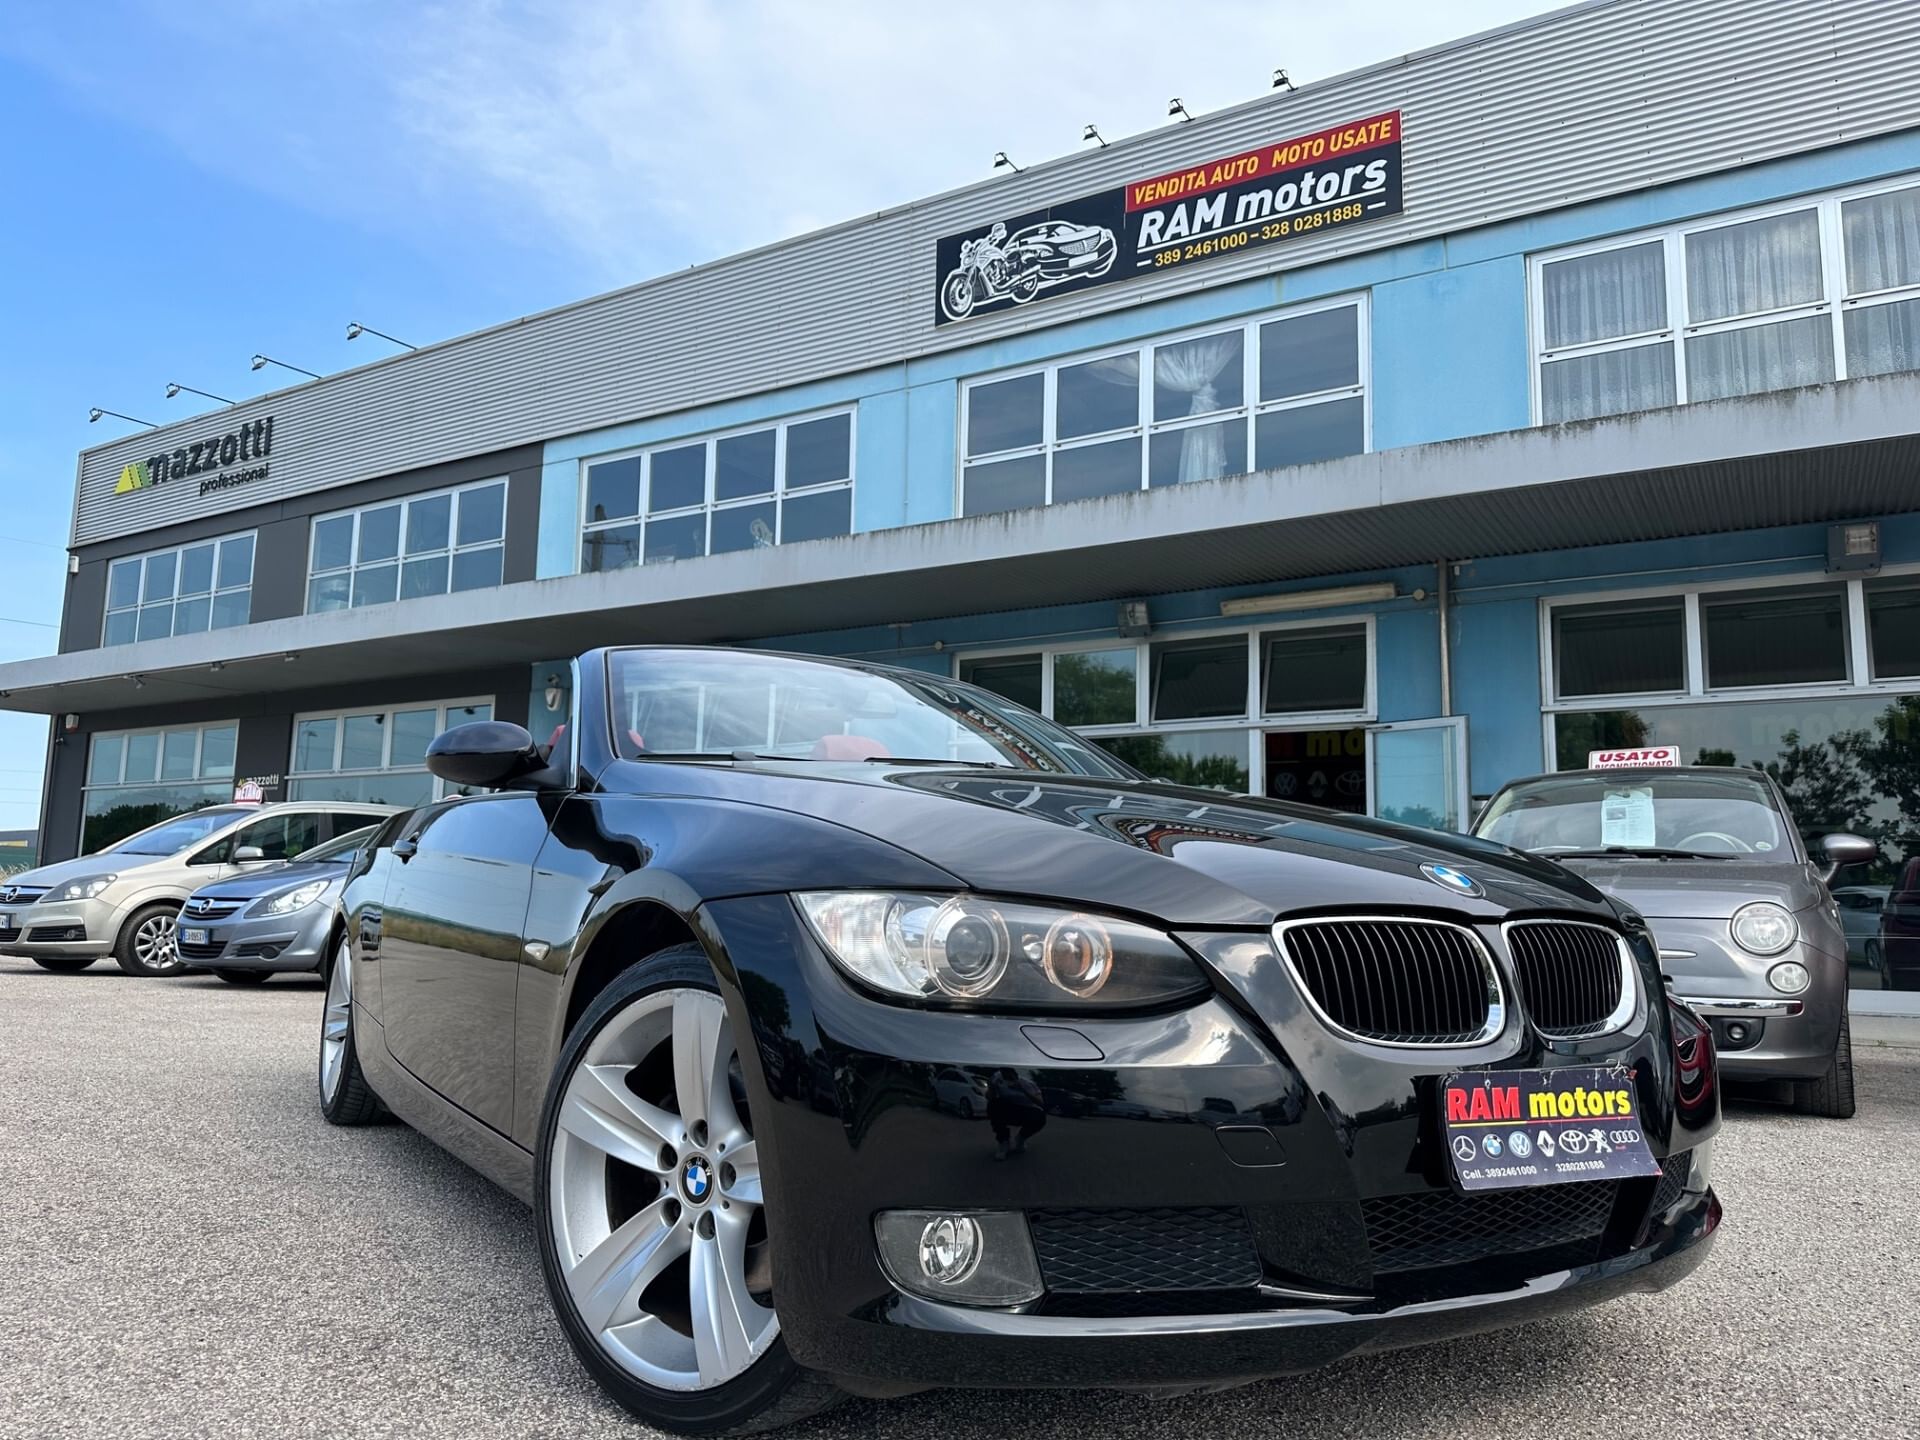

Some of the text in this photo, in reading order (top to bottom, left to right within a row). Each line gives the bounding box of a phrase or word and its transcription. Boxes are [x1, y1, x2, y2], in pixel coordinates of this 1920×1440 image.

[1134, 119, 1393, 205] VENDITA AUTO MOTO USATE
[1137, 159, 1388, 248] RAM motors
[1155, 248, 1181, 267] 389
[1184, 231, 1247, 259] 2461000
[1261, 220, 1290, 240] 328
[1293, 203, 1362, 232] 0281888
[148, 416, 274, 485] mazzotti
[200, 463, 270, 496] professional
[1599, 750, 1669, 762] USATO
[1447, 1087, 1632, 1121] RAM motors
[1462, 1169, 1485, 1180] Cell.
[1486, 1165, 1538, 1178] 3892461000
[1555, 1160, 1606, 1173] 3280281888
